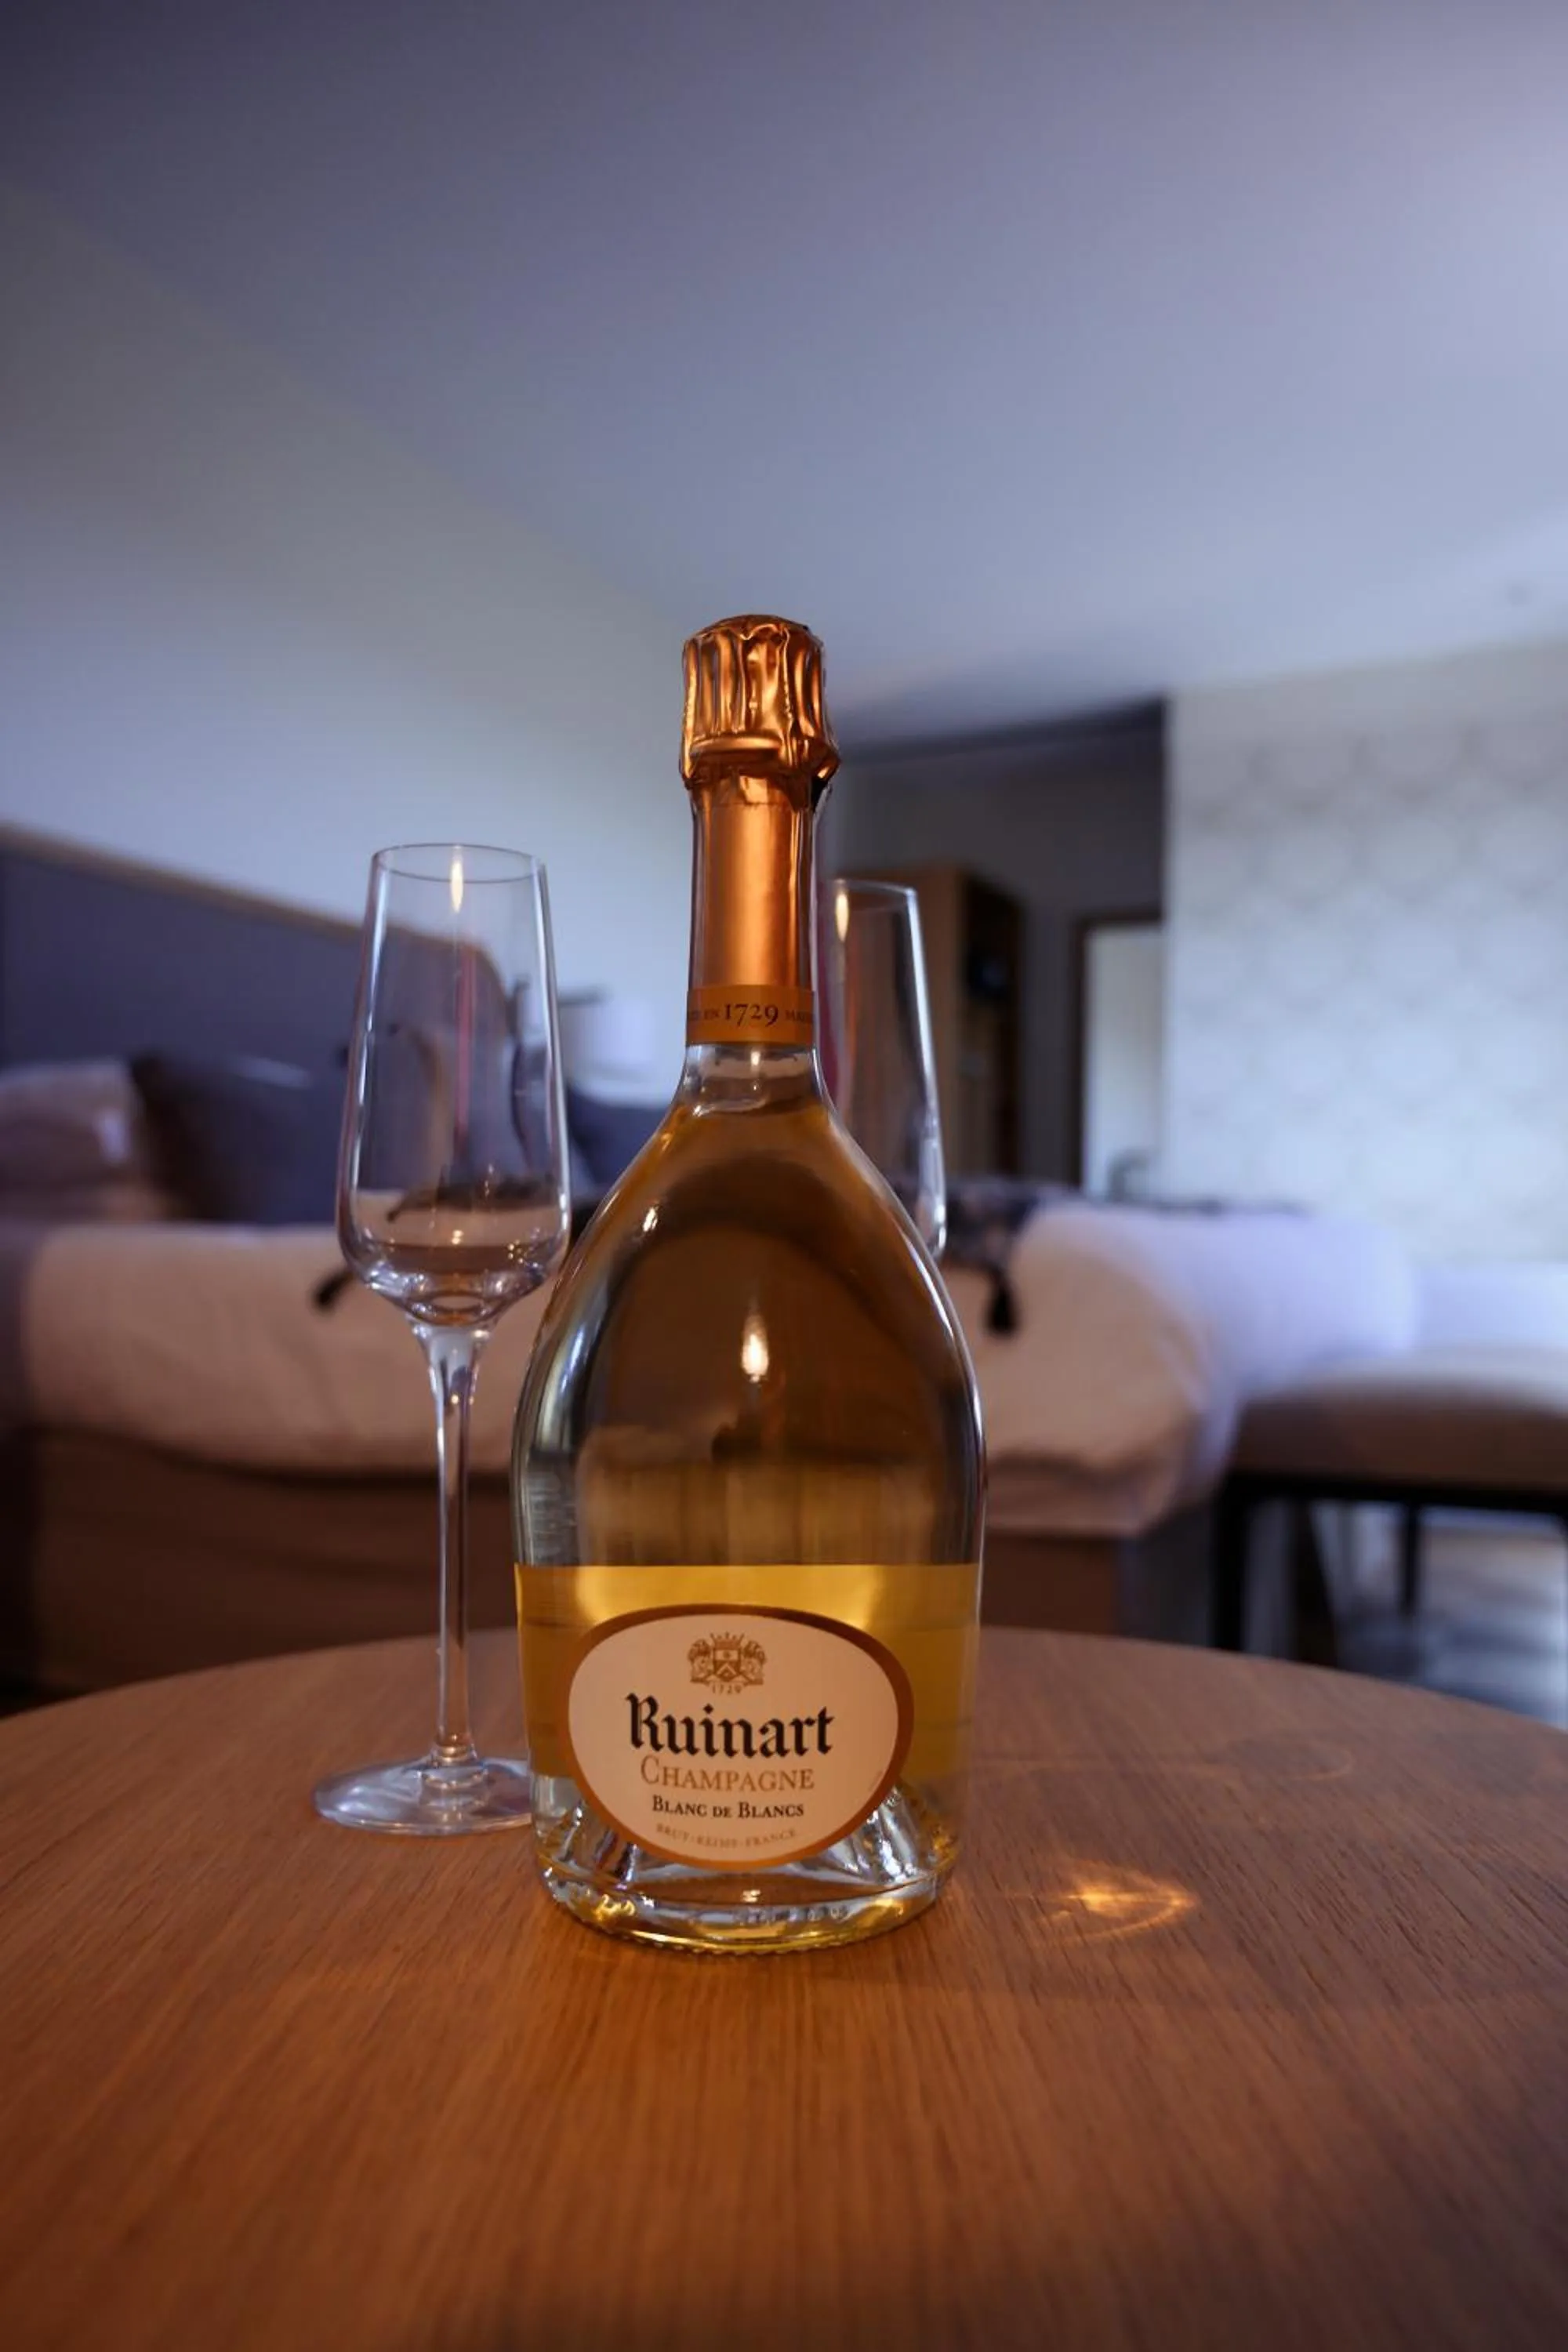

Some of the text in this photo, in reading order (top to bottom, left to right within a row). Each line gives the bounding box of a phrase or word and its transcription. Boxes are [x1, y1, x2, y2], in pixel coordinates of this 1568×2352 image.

[725, 1004, 779, 1026] 1729
[626, 1693, 834, 1757] Ruinart
[640, 1755, 815, 1792] CHAMPAGNE
[652, 1795, 804, 1818] BLANC DE BLANCS
